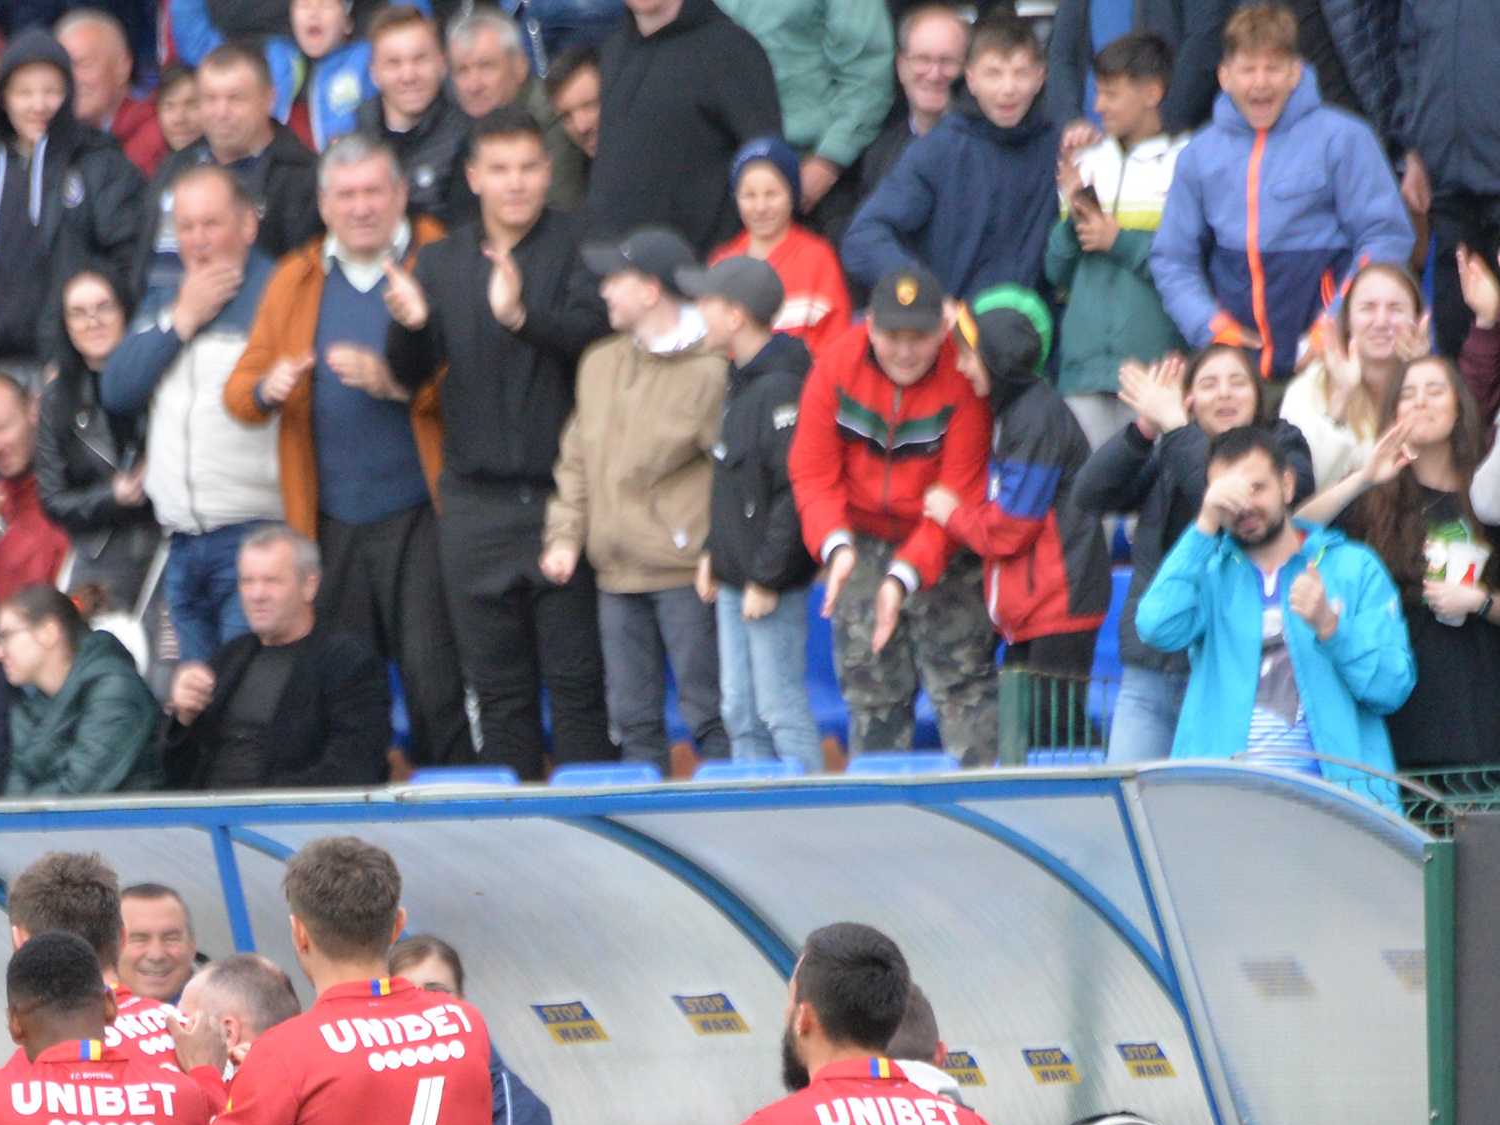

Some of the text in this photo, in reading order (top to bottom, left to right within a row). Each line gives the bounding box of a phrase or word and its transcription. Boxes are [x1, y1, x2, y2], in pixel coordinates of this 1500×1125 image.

[682, 995, 725, 1014] STOP
[542, 1004, 584, 1022] STOP
[556, 1026, 601, 1042] WAR!
[944, 1053, 970, 1067] TOP
[1028, 1051, 1064, 1066] STOP
[1124, 1046, 1158, 1060] STOP
[952, 1072, 978, 1085] AR!
[1037, 1070, 1071, 1083] WAR!
[1132, 1065, 1169, 1078] WAR!
[11, 1080, 176, 1116] UNIBET
